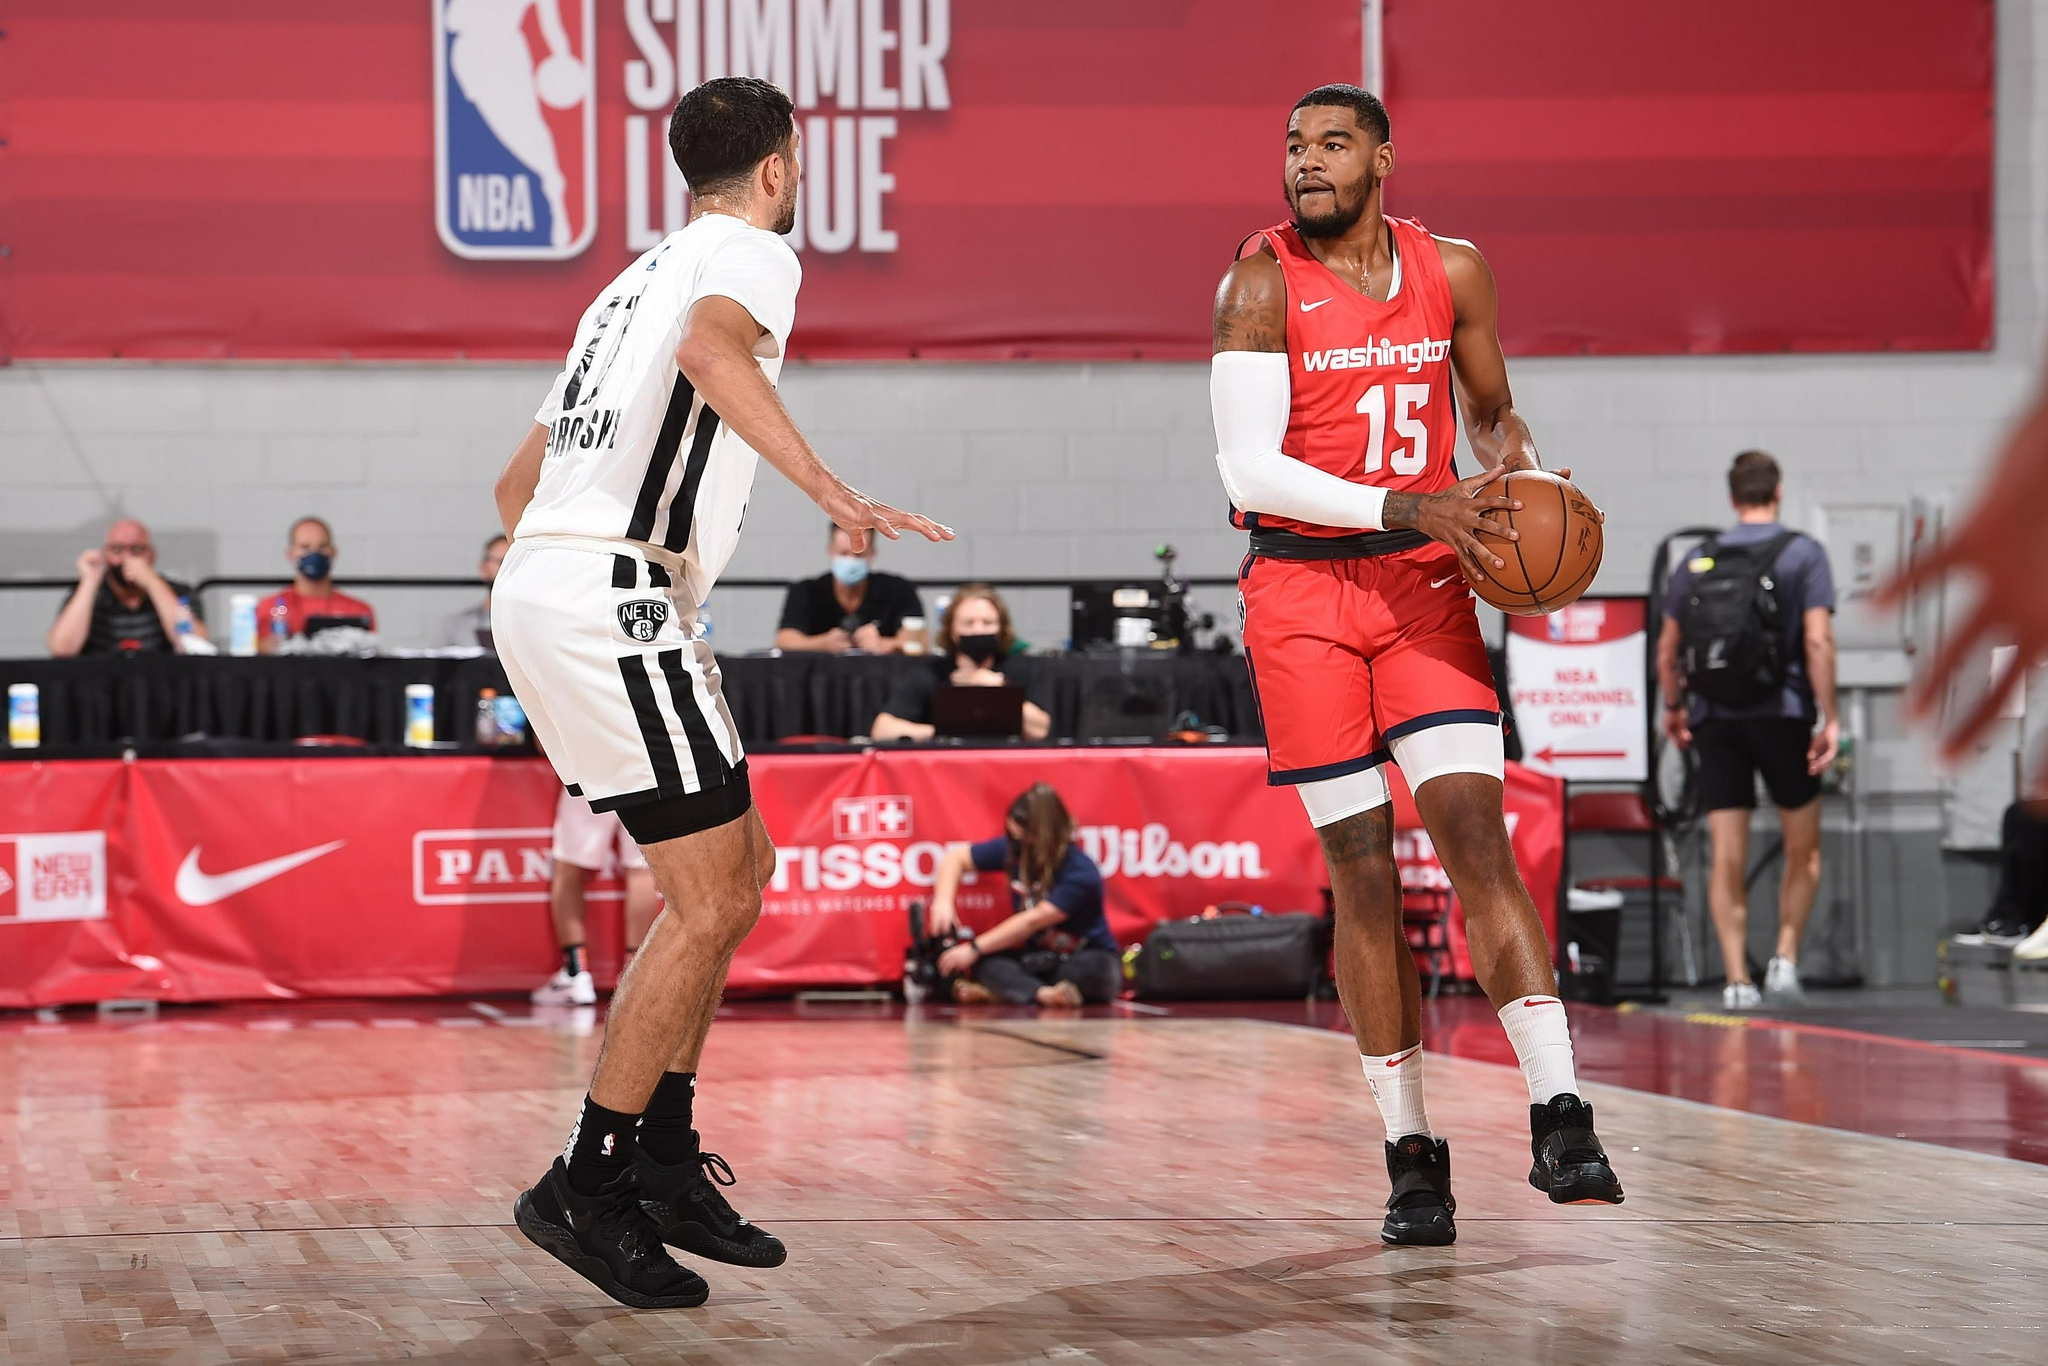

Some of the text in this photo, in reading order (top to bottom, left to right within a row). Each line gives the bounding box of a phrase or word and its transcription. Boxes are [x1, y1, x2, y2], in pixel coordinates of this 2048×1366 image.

[624, 0, 951, 111] SUMMER
[458, 174, 535, 232] NBA
[624, 116, 899, 254] LUE
[1302, 334, 1452, 373] washington
[1355, 383, 1430, 476] 15
[623, 603, 665, 622] NETS
[1555, 669, 1598, 684] NBA
[1514, 689, 1636, 707] PERSONNEL
[1549, 711, 1603, 728] ONLY
[32, 853, 92, 877] NEW
[436, 847, 616, 885] PAN
[1075, 822, 1265, 880] Wilson
[33, 877, 93, 902] ERA
